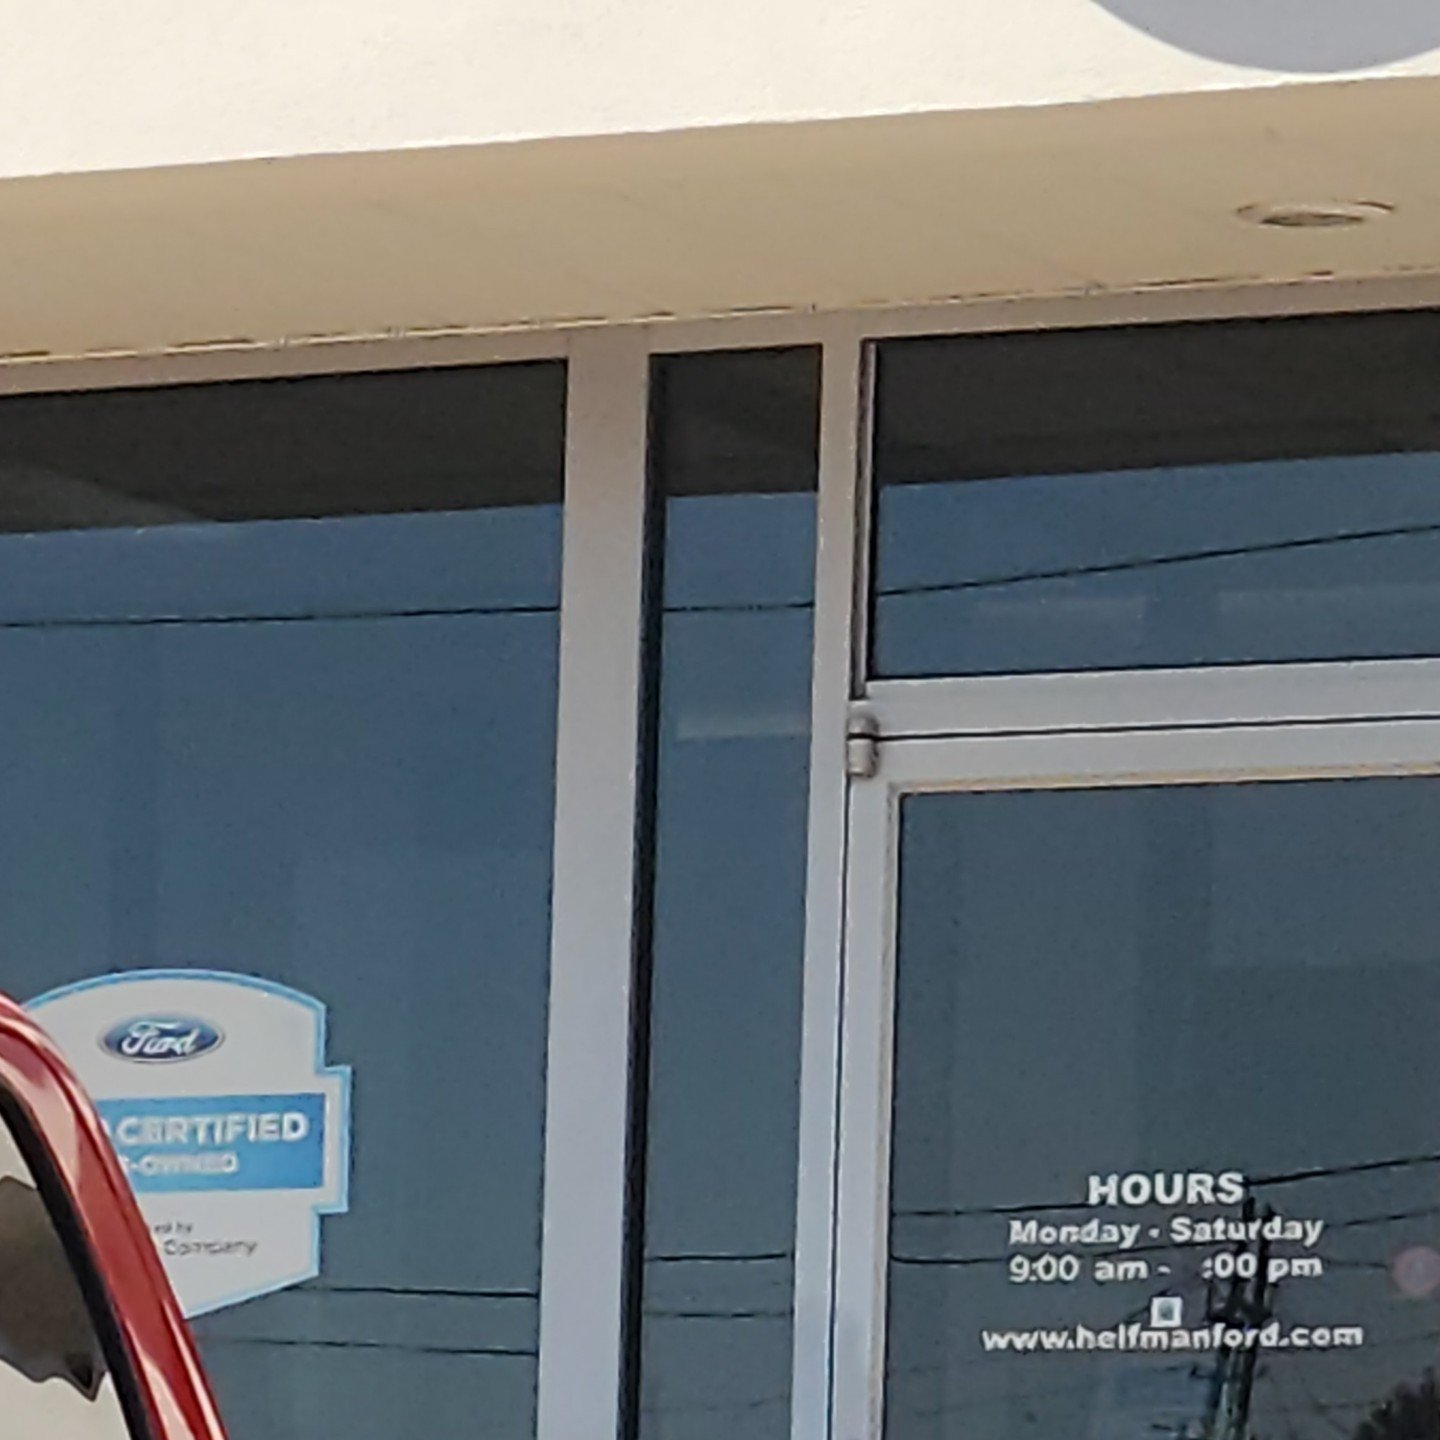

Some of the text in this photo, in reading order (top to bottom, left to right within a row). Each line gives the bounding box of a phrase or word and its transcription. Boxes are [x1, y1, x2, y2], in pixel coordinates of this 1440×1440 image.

[121, 1020, 199, 1056] Ford
[116, 1112, 309, 1145] CERTIFIED
[1088, 1172, 1244, 1206] HOURS
[1008, 1218, 1140, 1249] Monday
[1169, 1216, 1325, 1248] Saturday
[1008, 1254, 1080, 1283] 9:00
[1094, 1261, 1148, 1282] am
[1202, 1252, 1257, 1280] :00
[1268, 1257, 1324, 1284] pm
[981, 1322, 1365, 1352] www.helfmanford.com
